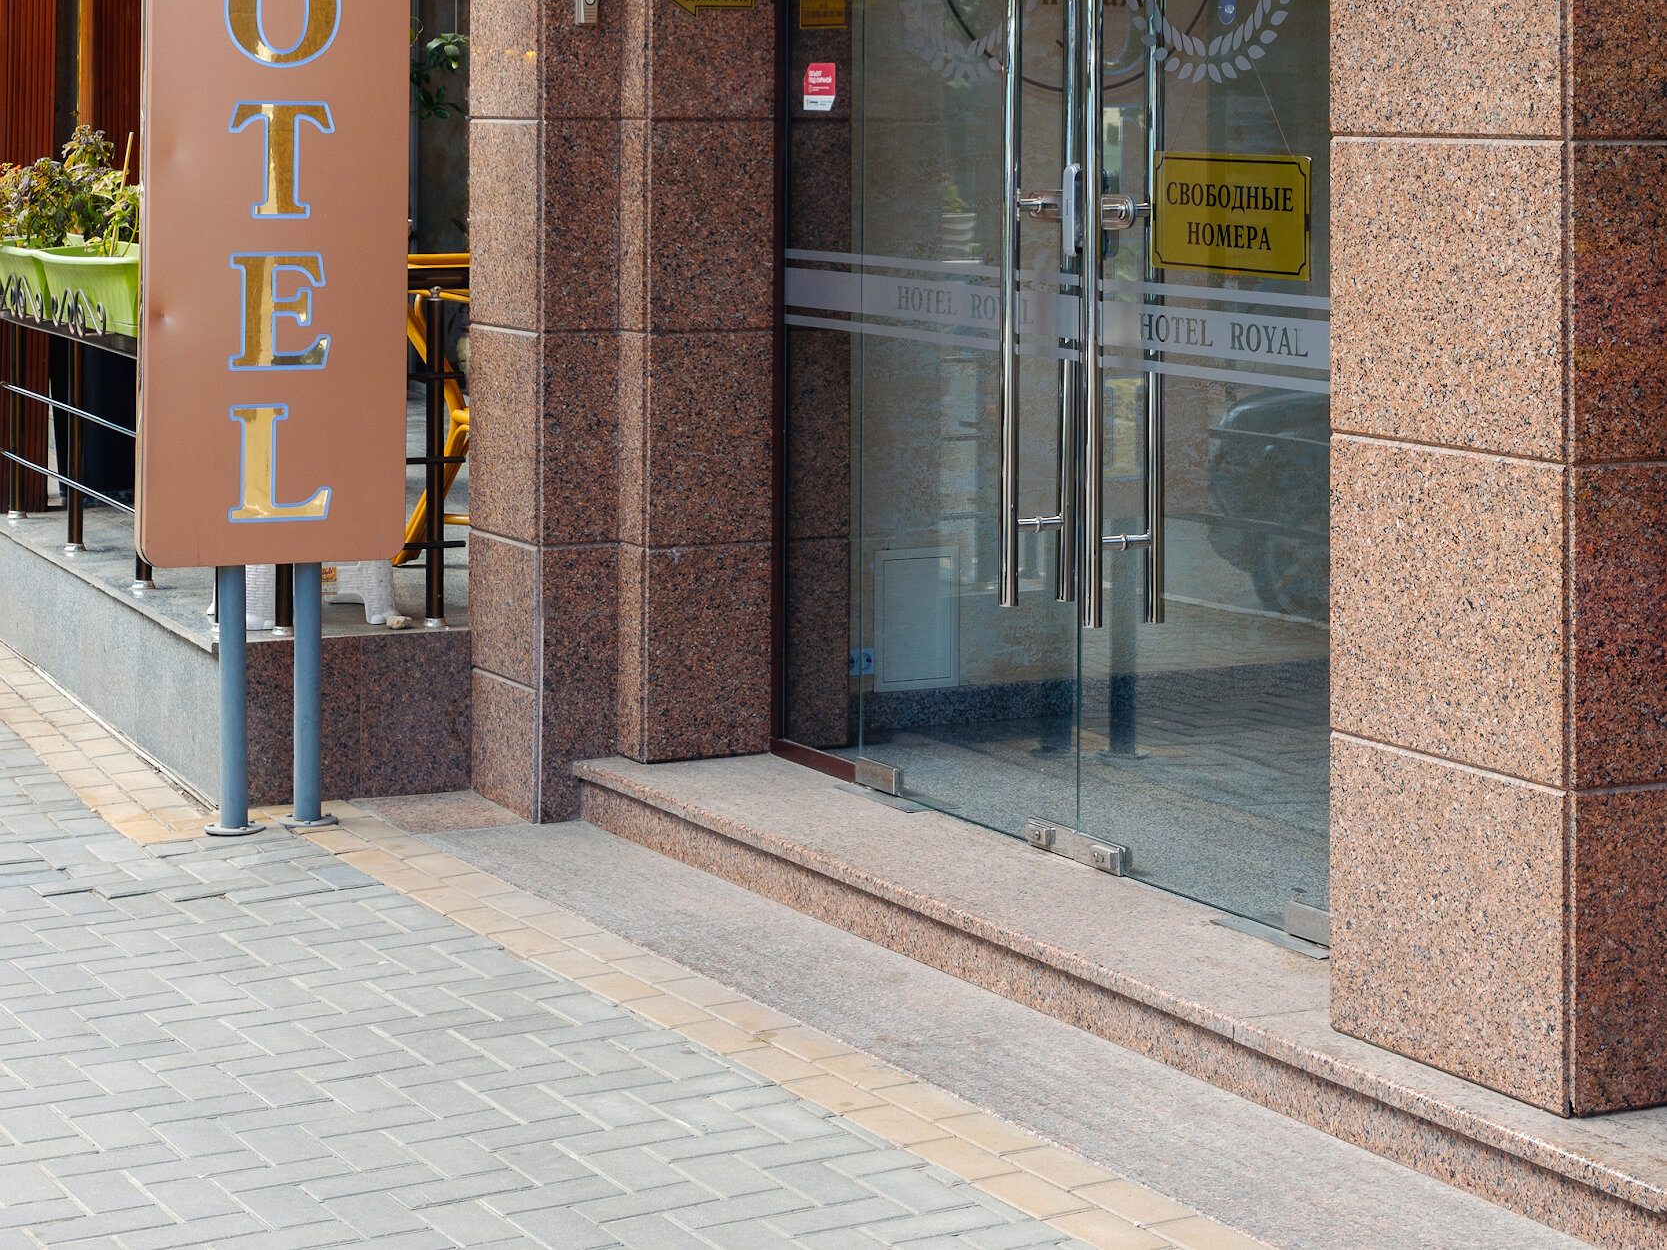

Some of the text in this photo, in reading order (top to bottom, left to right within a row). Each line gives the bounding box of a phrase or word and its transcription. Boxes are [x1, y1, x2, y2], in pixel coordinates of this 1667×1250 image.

[1166, 181, 1294, 214] СВОБОДНЫЕ
[1187, 221, 1272, 251] НОМЕРА
[896, 285, 958, 316] HOTEL
[1139, 313, 1309, 357] HOTEL ROYAL
